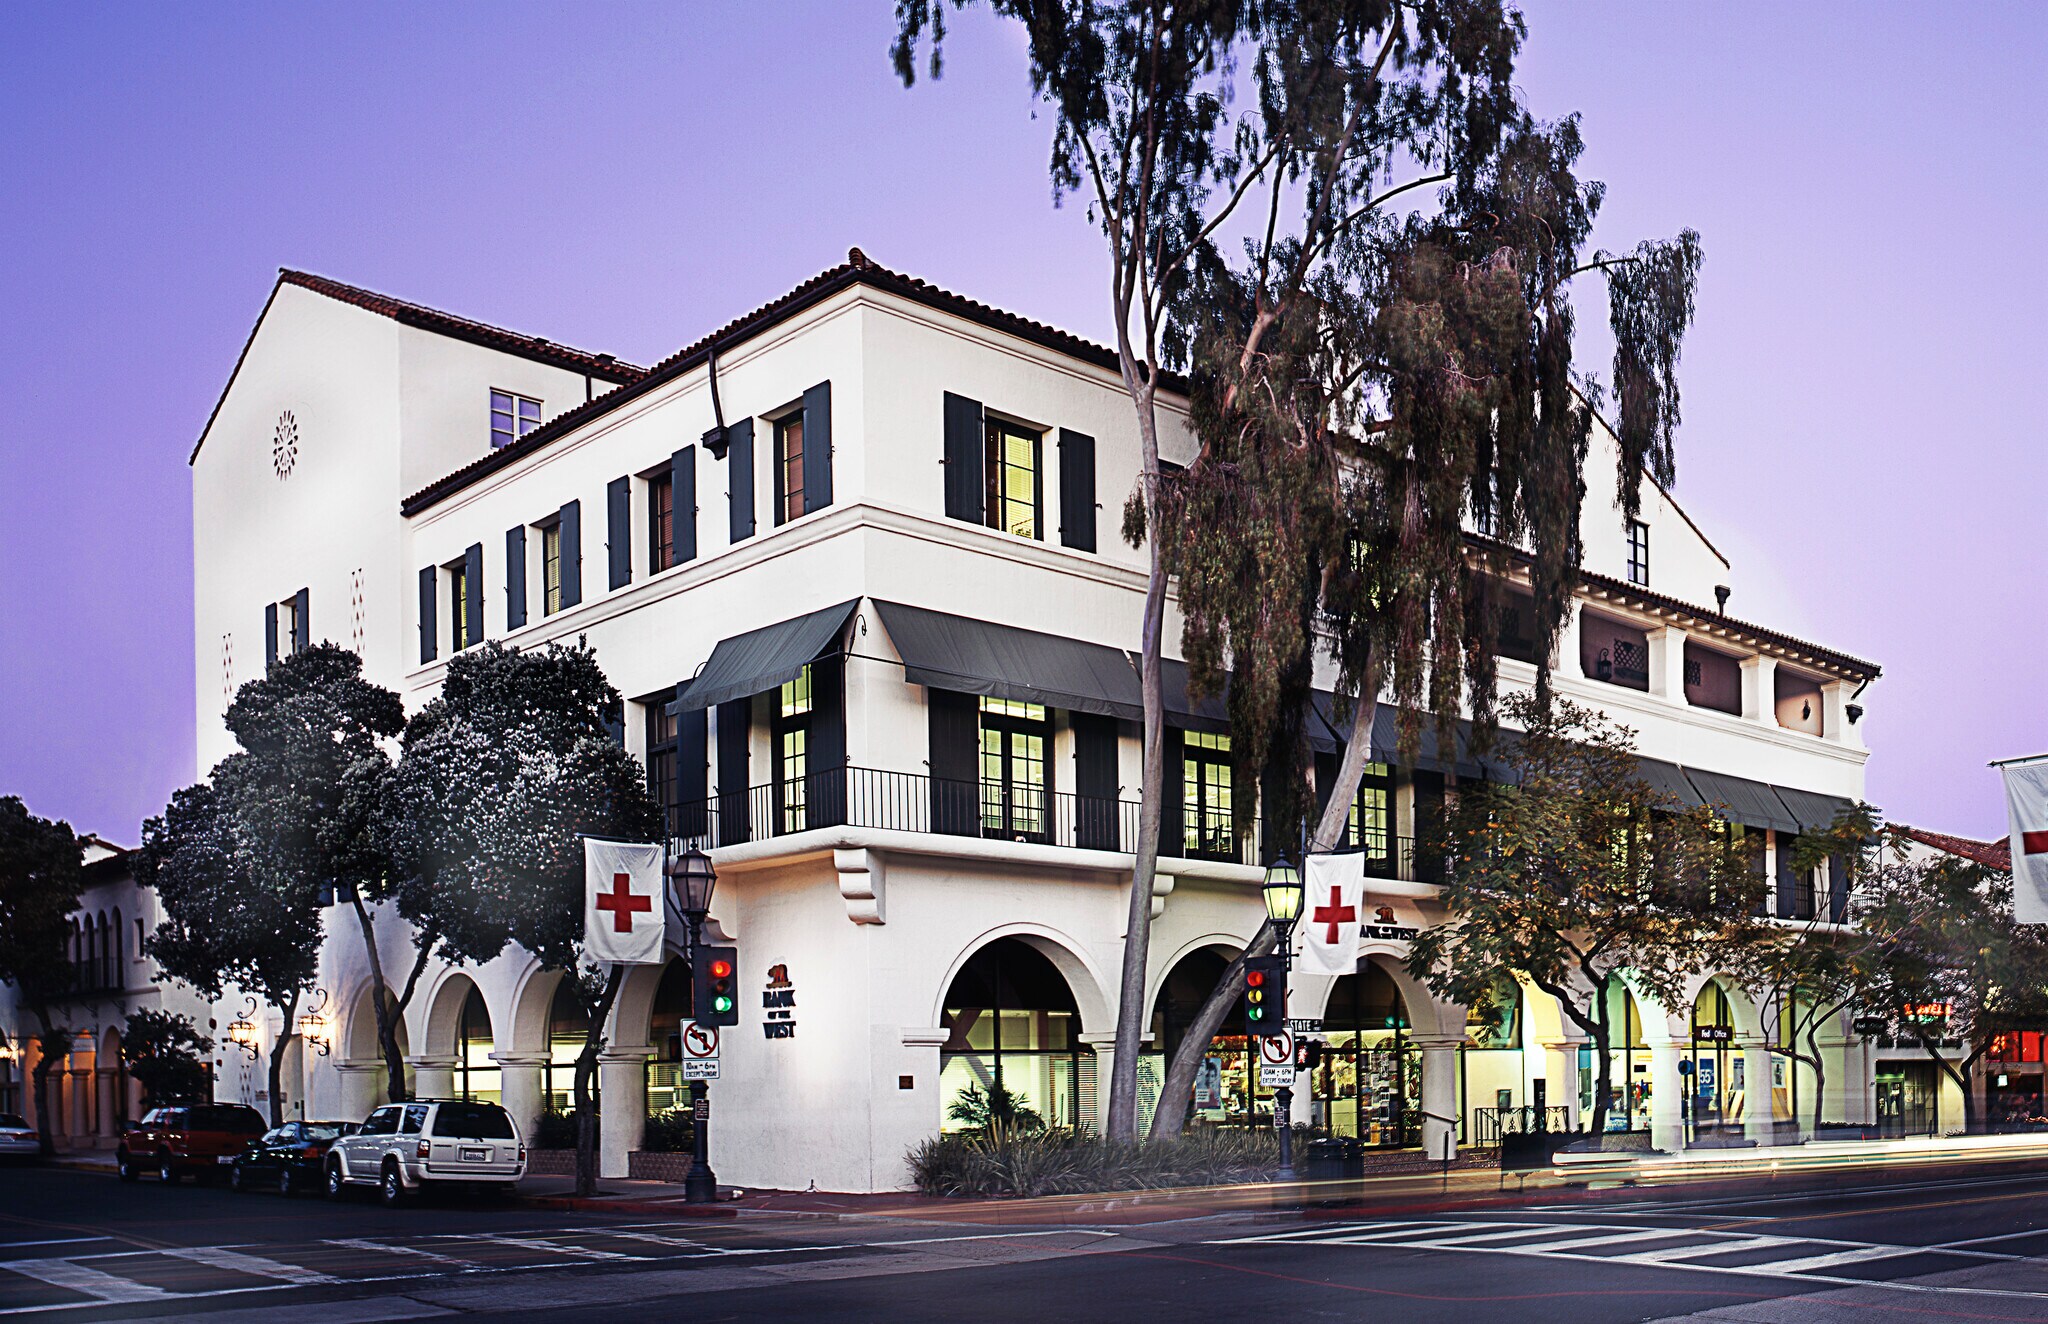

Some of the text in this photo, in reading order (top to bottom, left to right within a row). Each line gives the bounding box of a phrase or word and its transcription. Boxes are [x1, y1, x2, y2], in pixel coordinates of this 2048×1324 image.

[1360, 925, 1382, 939] ANK
[762, 990, 796, 1008] BANK
[762, 1021, 796, 1039] WEST
[1290, 1020, 1311, 1031] STATE
[1714, 1029, 1727, 1038] Office
